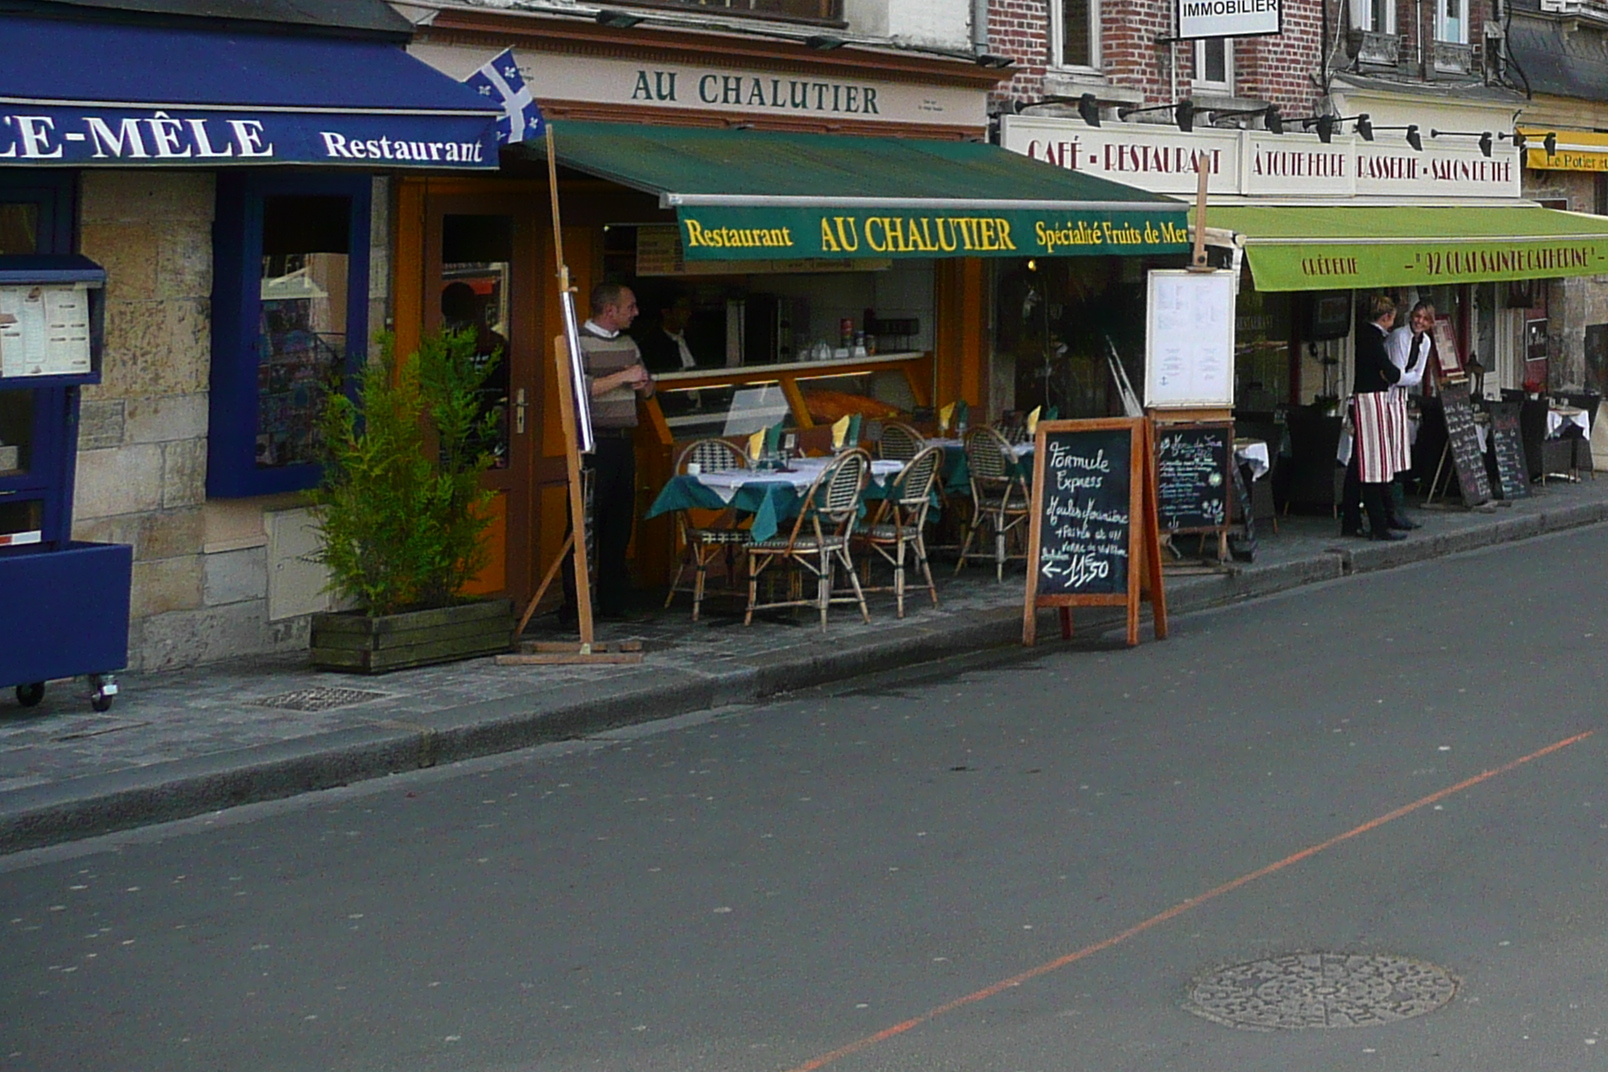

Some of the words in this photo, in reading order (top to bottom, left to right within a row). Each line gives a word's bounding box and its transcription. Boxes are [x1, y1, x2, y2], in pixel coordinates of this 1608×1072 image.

[632, 70, 677, 102] AU
[699, 73, 880, 115] CHALUTIER
[320, 130, 484, 163] Restaurant
[1027, 135, 1083, 171] CAFÉ
[1564, 154, 1597, 169] Potier
[1265, 151, 1305, 176] TOUTE
[1307, 152, 1346, 177] HEURE
[1356, 155, 1420, 180] RASSERIE
[1430, 157, 1471, 181] SALON
[1472, 160, 1488, 182] DE
[1490, 157, 1512, 183] THÉ
[684, 218, 794, 248] Restaurant
[821, 217, 859, 252] AU
[864, 217, 1018, 252] CHALUTIER
[1035, 220, 1102, 254] Spécialité
[1102, 221, 1142, 244] Fruits
[1144, 220, 1160, 244] de
[1160, 221, 1188, 244] Mer
[1302, 253, 1359, 276] CRÊPERIE
[1426, 253, 1443, 275] 92
[1446, 251, 1477, 274] QUAI
[1480, 249, 1525, 273] SAINTE
[1526, 247, 1589, 270] CATHERINE
[1050, 441, 1110, 473] Formule
[1057, 470, 1103, 493] Express
